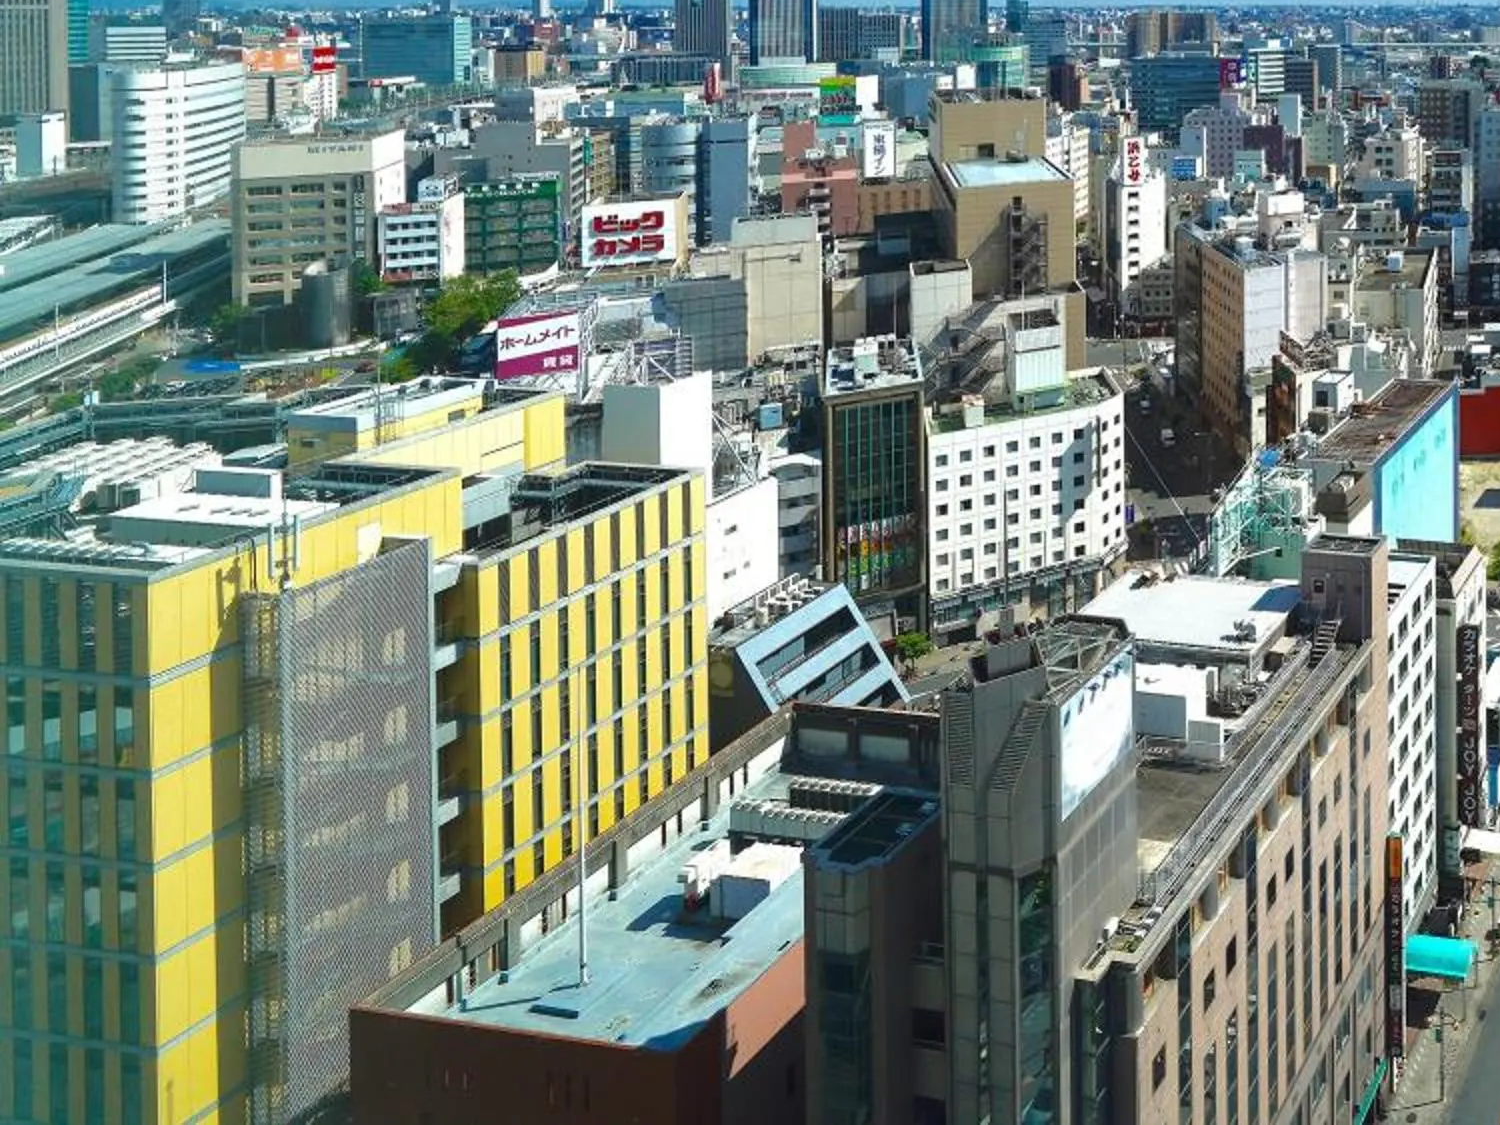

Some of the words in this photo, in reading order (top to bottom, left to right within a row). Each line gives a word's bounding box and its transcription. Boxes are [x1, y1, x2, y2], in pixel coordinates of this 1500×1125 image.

[592, 210, 665, 234] ビック
[592, 234, 665, 256] カメラ
[499, 324, 576, 351] ホームメイト
[1463, 629, 1477, 675] カラオケ
